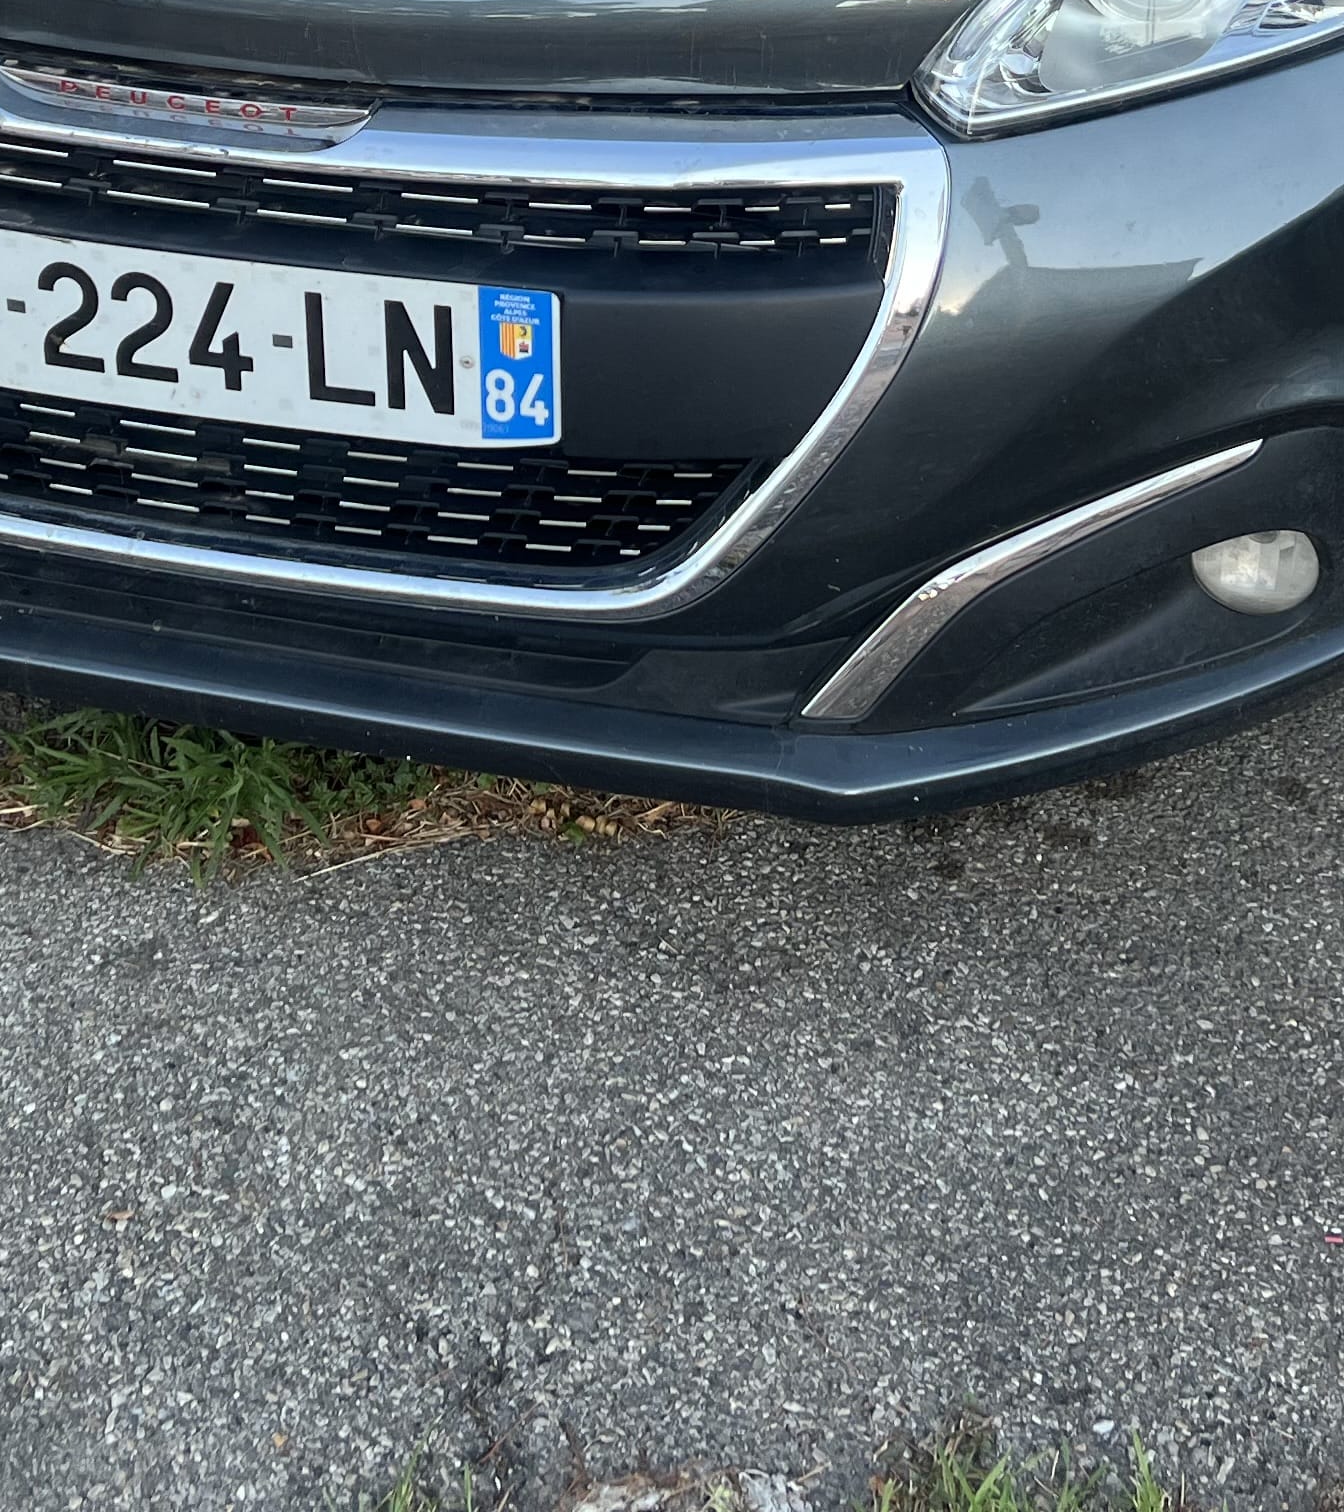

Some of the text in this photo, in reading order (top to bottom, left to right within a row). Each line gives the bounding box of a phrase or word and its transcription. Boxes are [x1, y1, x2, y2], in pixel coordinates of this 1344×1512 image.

[58, 79, 298, 121] PEUGEOT
[494, 300, 536, 311] PROVENCE
[503, 308, 528, 317] ALPES
[484, 368, 549, 426] 84
